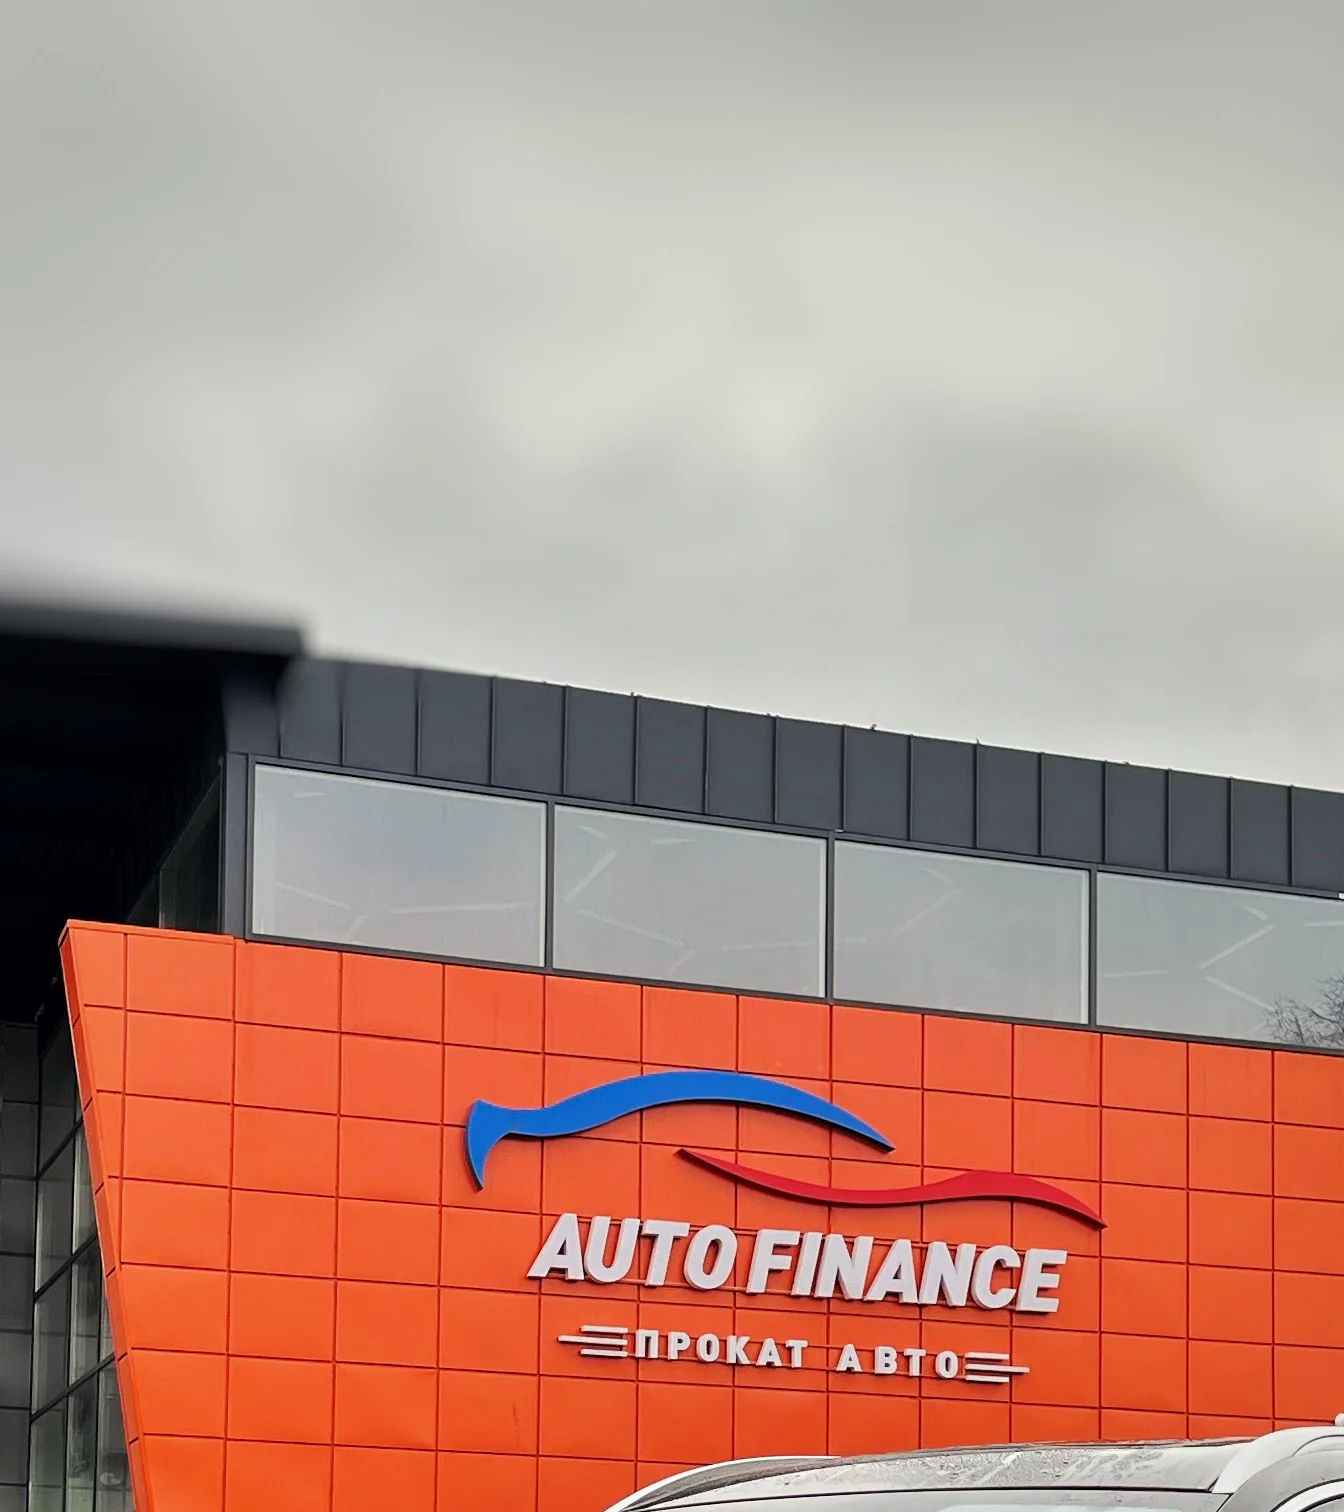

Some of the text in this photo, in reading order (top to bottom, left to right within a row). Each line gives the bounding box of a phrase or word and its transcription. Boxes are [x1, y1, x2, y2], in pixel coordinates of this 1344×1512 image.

[526, 1212, 1068, 1313] AUTO FINANCE
[634, 1328, 959, 1380] ПРОКАТ АВТО
